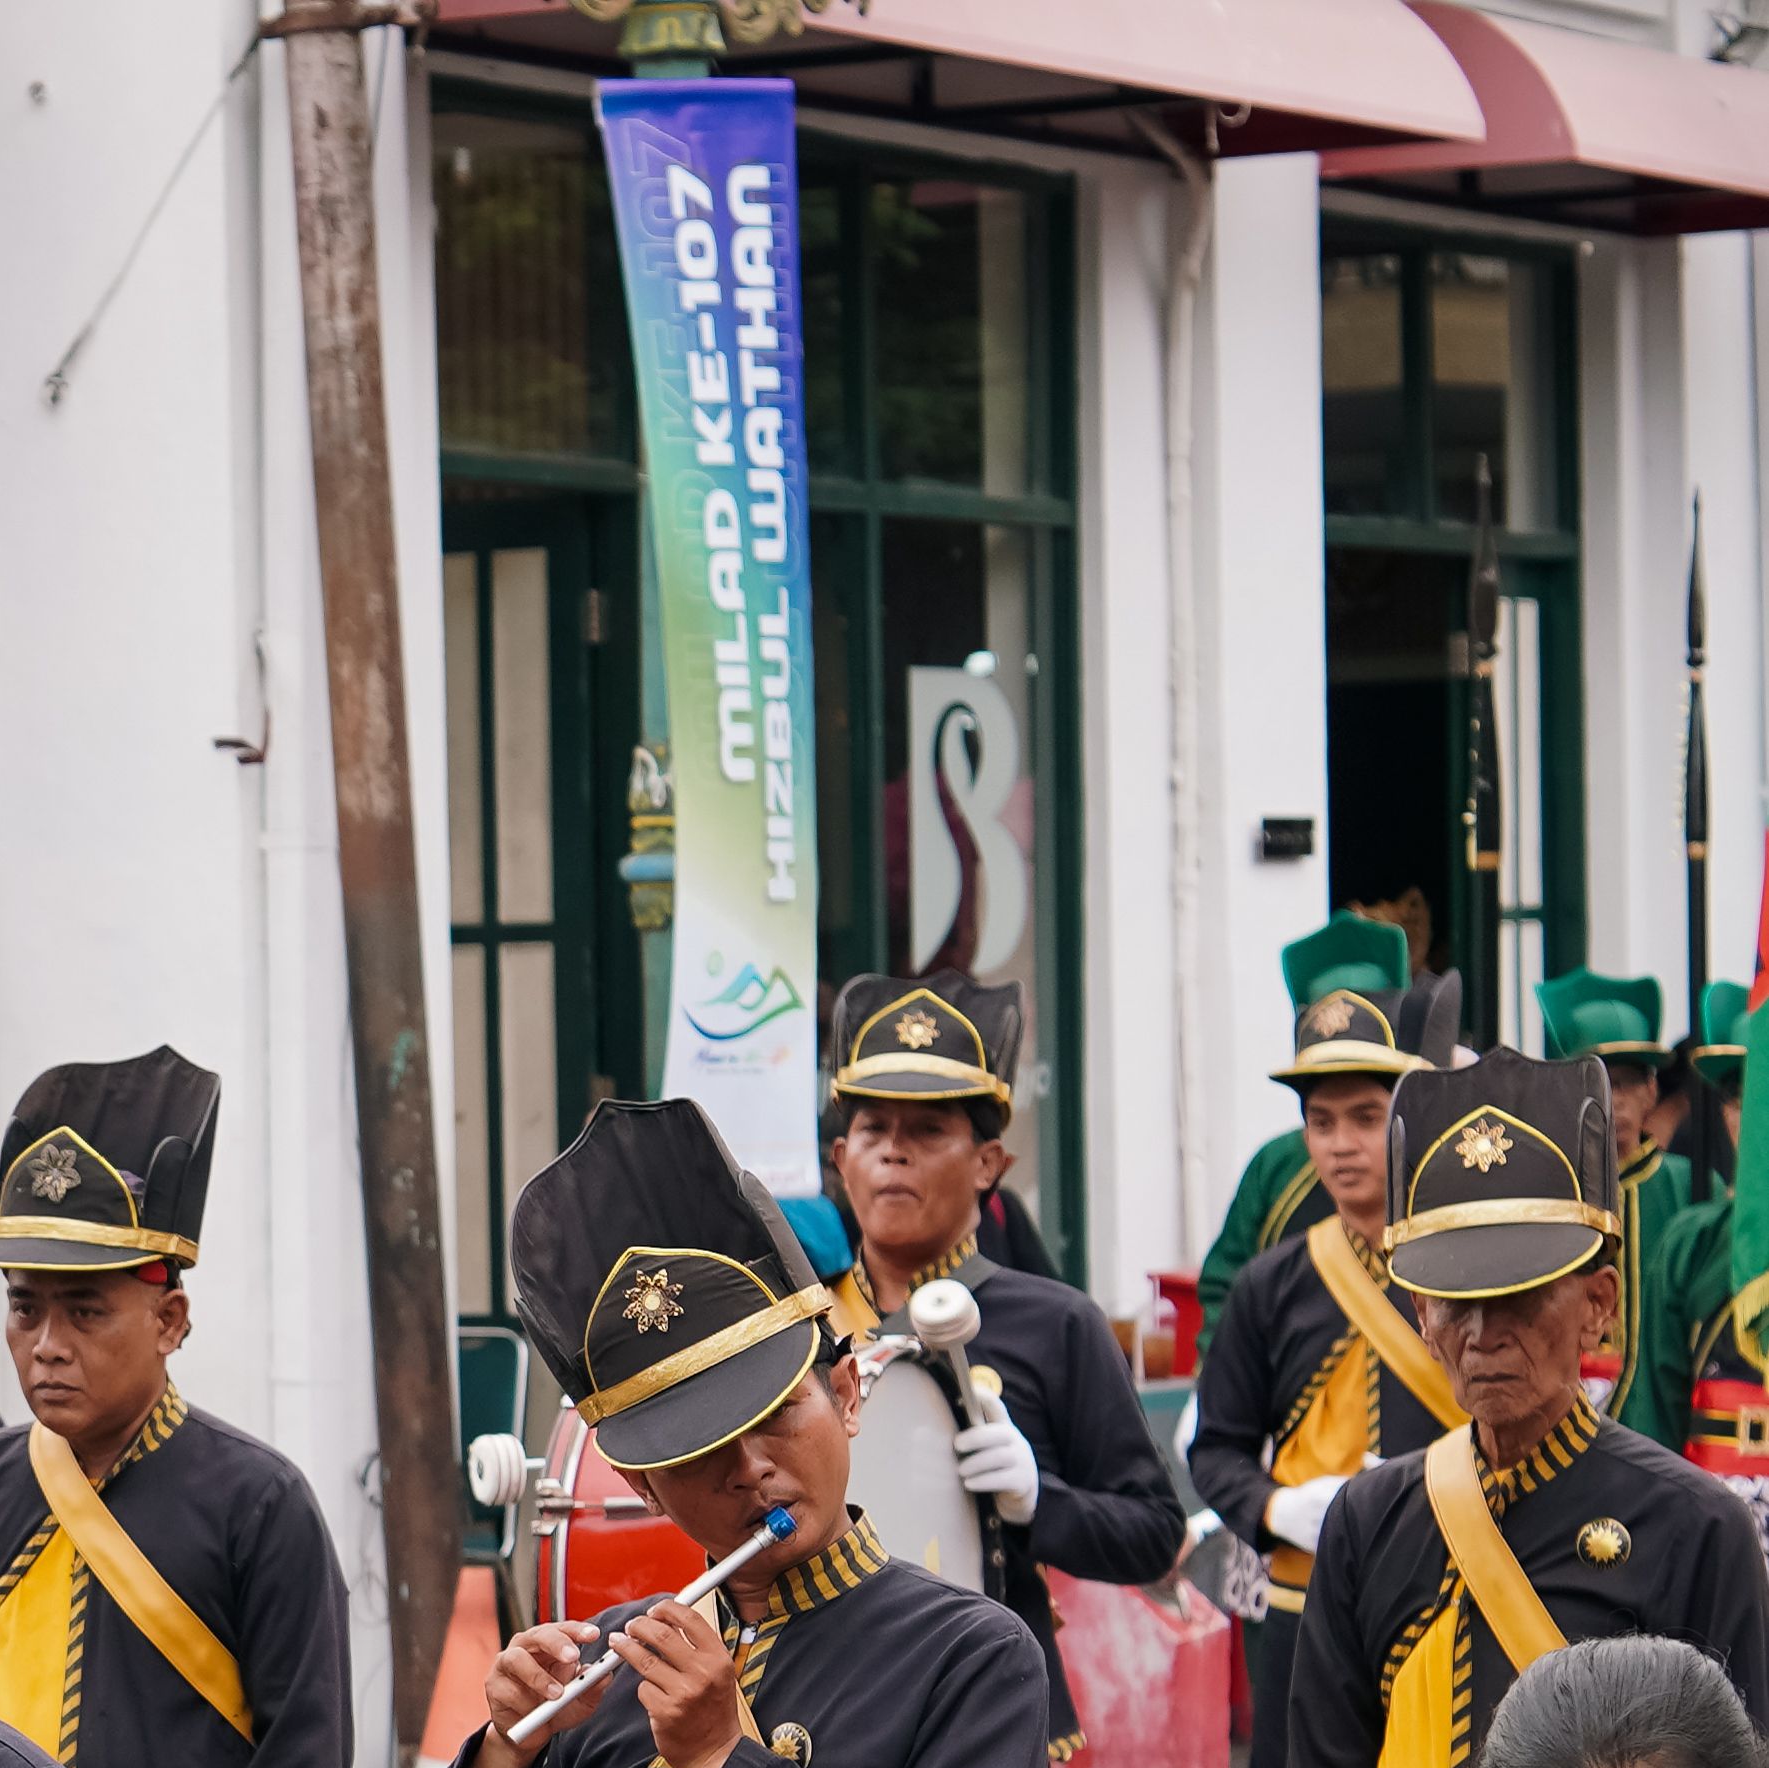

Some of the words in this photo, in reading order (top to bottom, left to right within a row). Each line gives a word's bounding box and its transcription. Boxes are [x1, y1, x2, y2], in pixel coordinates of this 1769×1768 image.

[667, 164, 735, 466] KE-107
[727, 164, 788, 563] WATHAN
[703, 488, 756, 783] MILAD
[759, 586, 796, 901] HIZBUL
